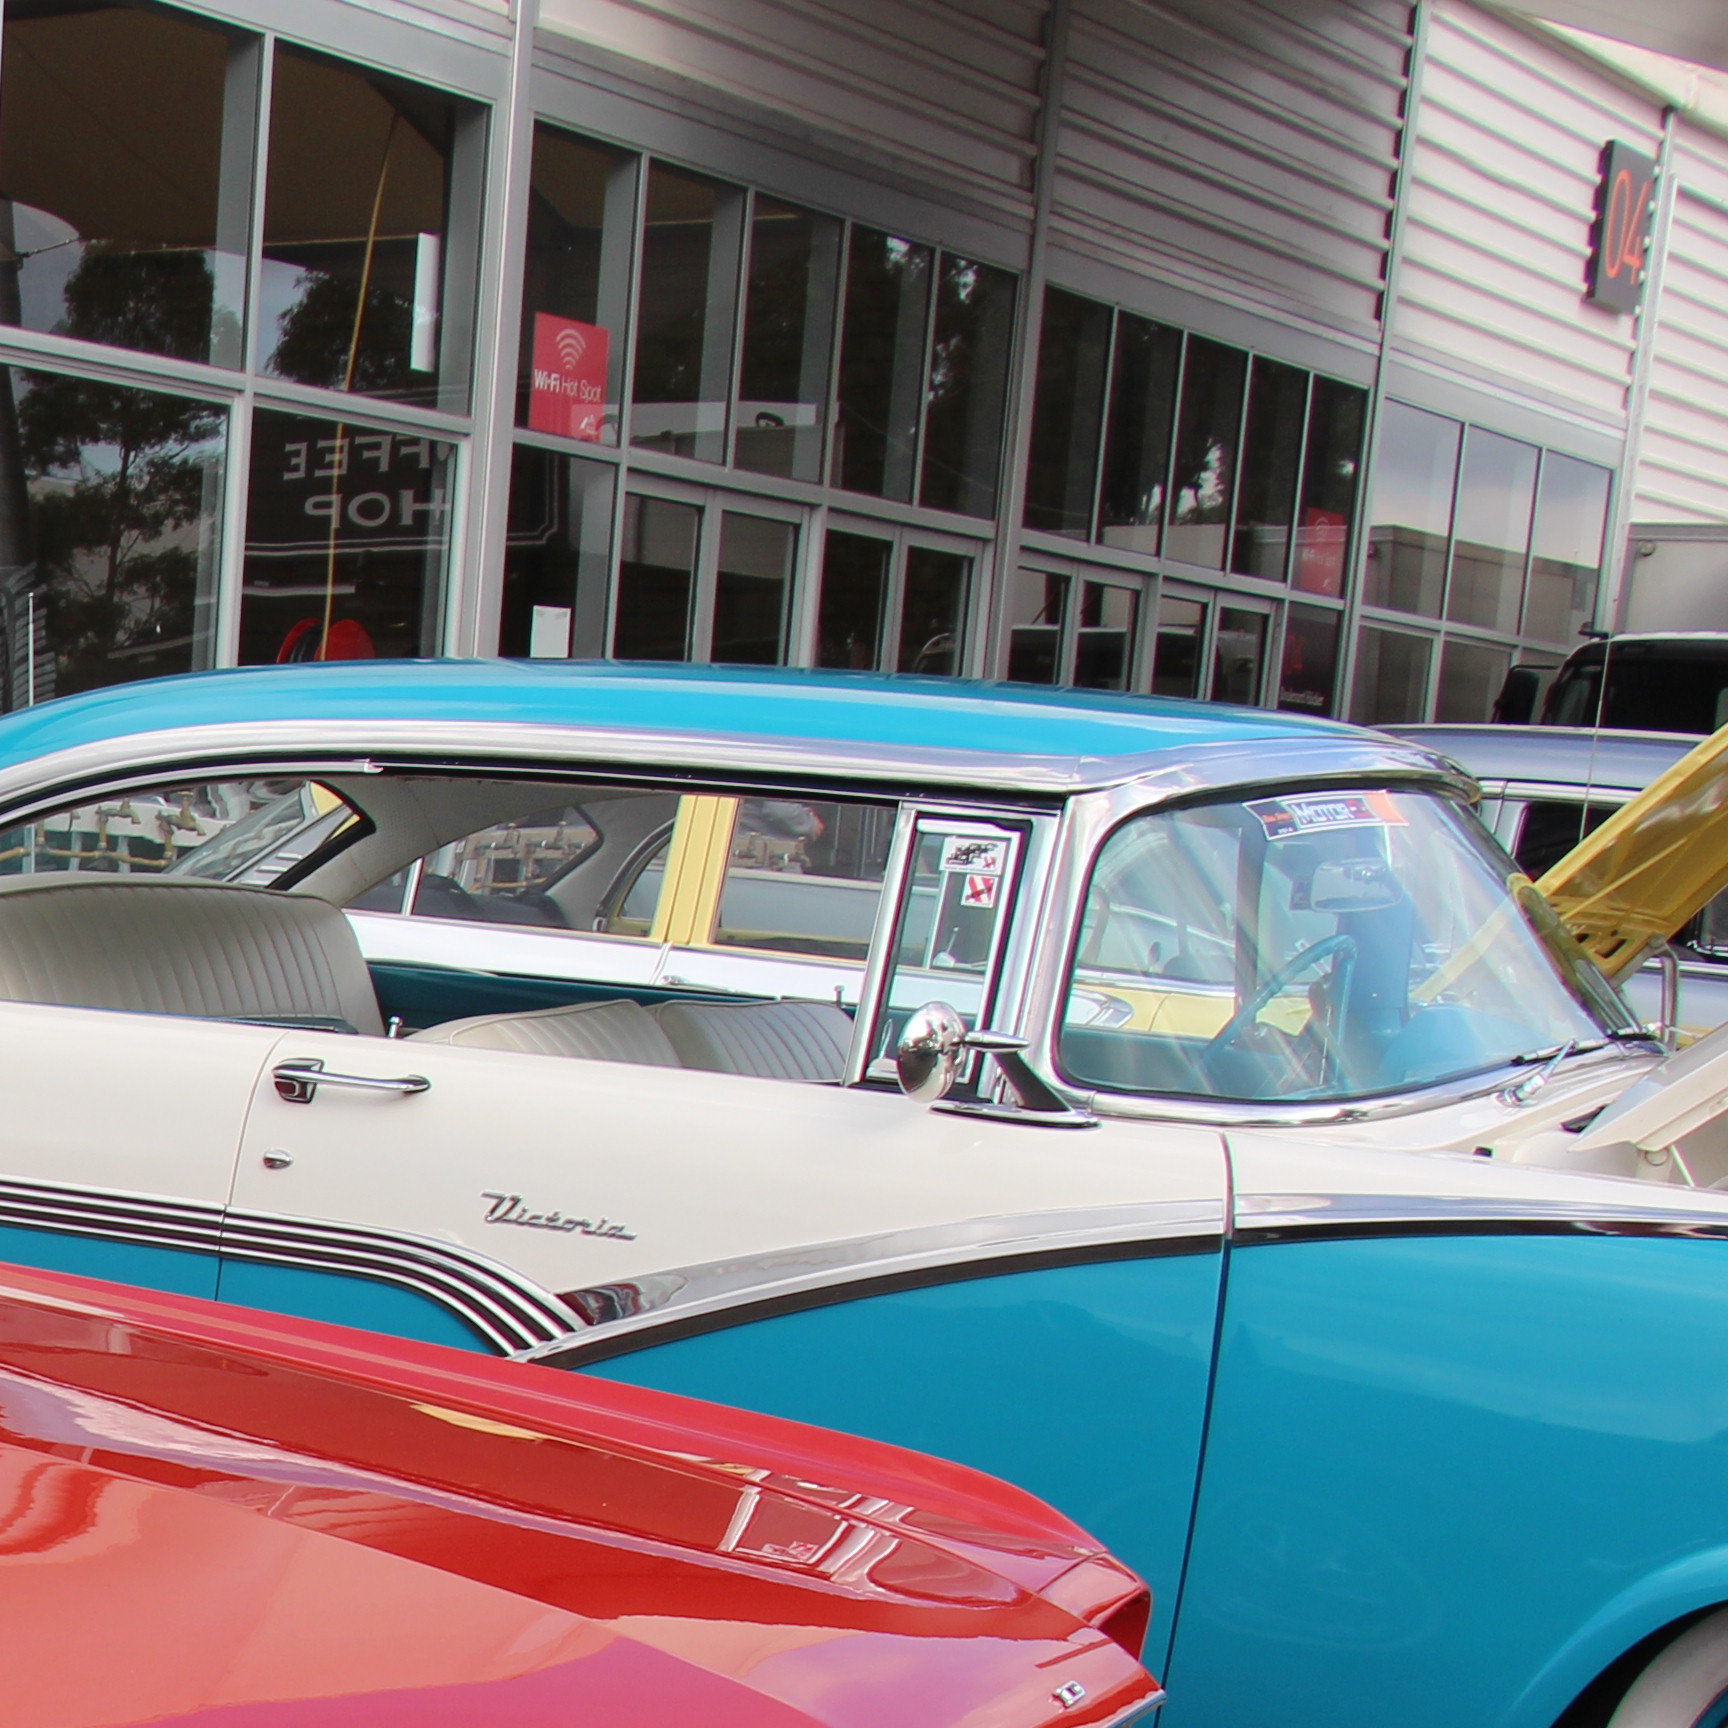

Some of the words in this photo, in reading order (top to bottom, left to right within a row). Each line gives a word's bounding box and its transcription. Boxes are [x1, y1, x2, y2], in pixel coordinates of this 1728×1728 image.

[1605, 169, 1651, 285] 04
[561, 376, 578, 397] Hot
[580, 379, 602, 403] Spot
[480, 1189, 638, 1242] Victoria
